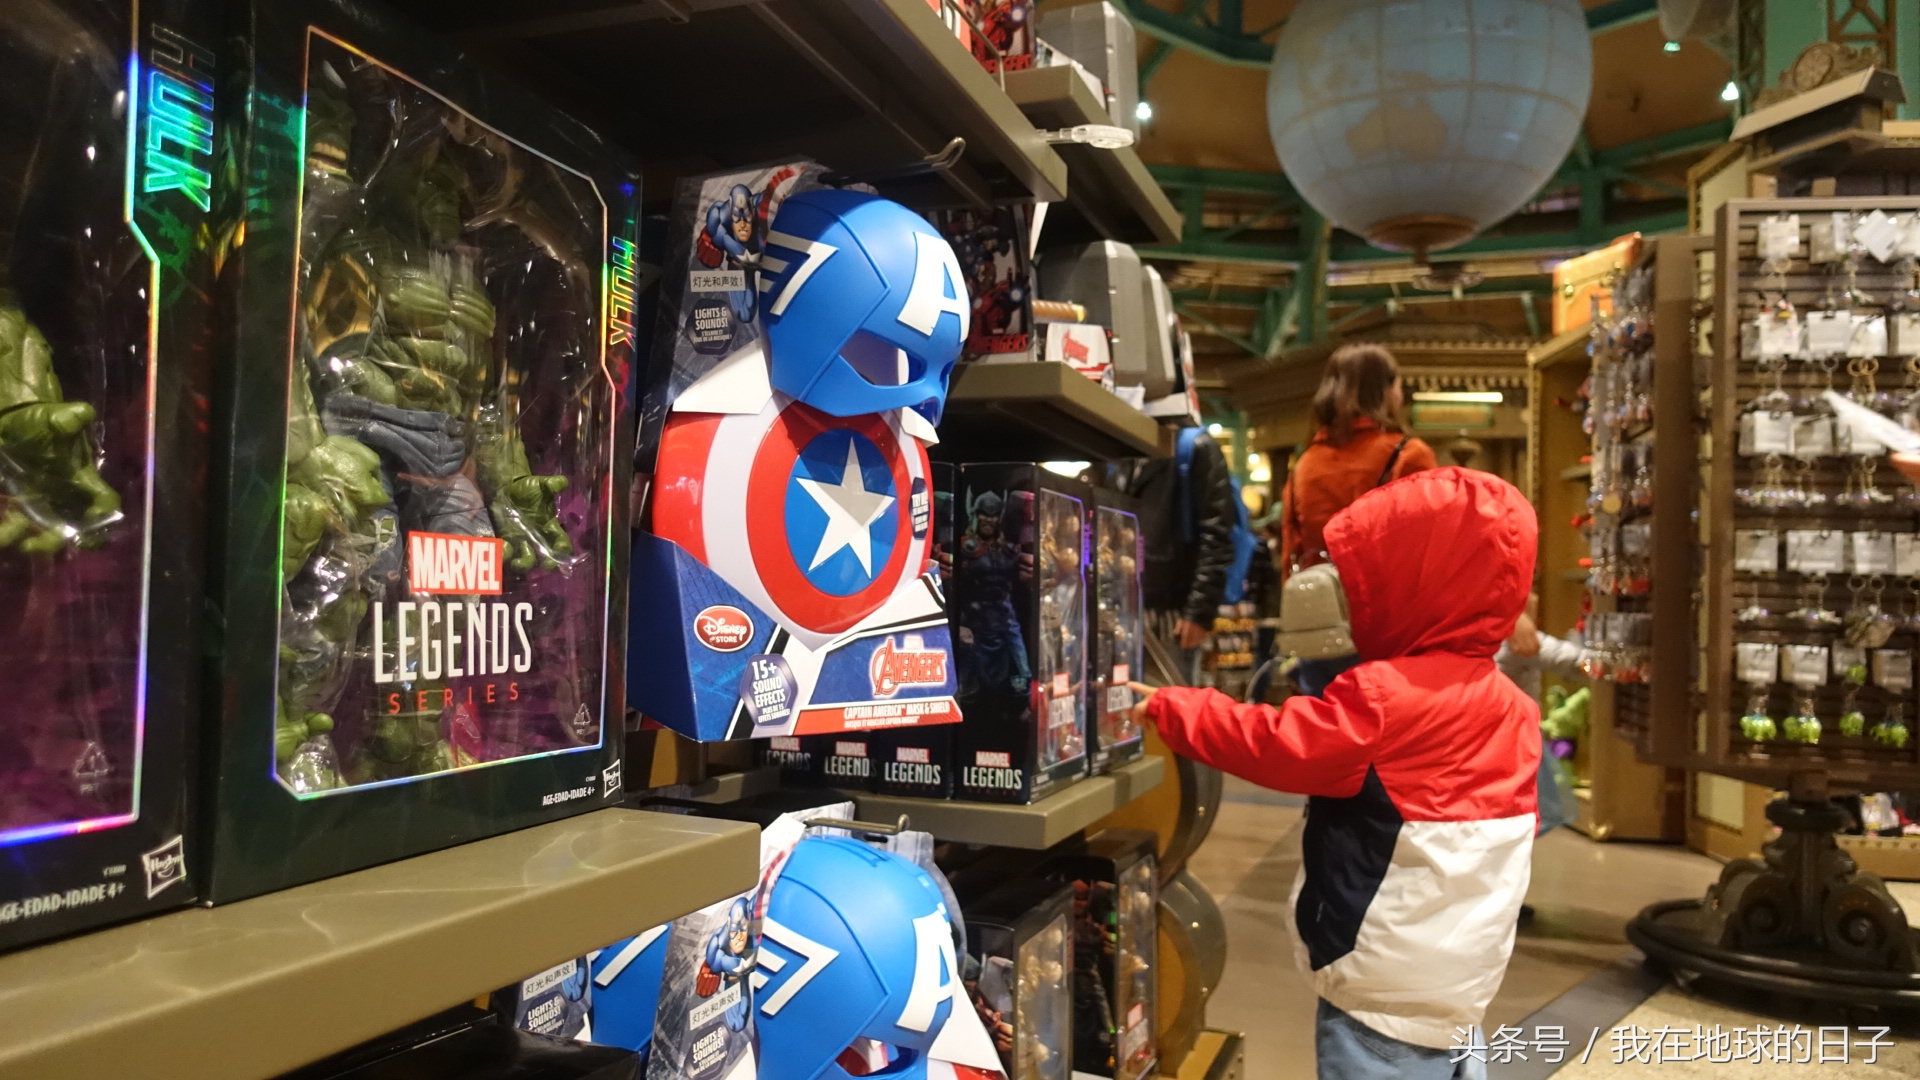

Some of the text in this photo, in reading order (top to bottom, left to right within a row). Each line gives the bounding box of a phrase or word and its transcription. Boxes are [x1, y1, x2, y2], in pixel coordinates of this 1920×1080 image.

[144, 22, 216, 213] HULK
[609, 235, 640, 353] HULK
[694, 306, 727, 320] LIGHTS &
[695, 317, 728, 331] SOUNDS!
[411, 535, 501, 591] MARVEL
[699, 615, 747, 641] Disney
[715, 635, 738, 643] STORE
[374, 601, 534, 684] LEGENDS
[752, 659, 778, 681] 15+
[871, 638, 946, 696] AVENGERS
[752, 676, 782, 695] SOUND
[388, 682, 519, 715] SERIES
[754, 688, 786, 708] EFFECTS
[844, 706, 873, 720] CAPTAIN
[905, 702, 924, 715] MASK
[929, 701, 950, 714] SHIELD
[835, 741, 867, 757] MARVEL
[896, 746, 930, 764] MARVEL
[975, 750, 1011, 769] MARVEL
[884, 761, 942, 786] LEGENDS
[963, 765, 1023, 791] LEGENDS
[107, 882, 126, 899] 4+
[528, 999, 553, 1021] LIGHTS
[528, 1006, 561, 1031] SOUNDS!
[692, 1030, 718, 1054] LIGHTS
[693, 1036, 725, 1064] SOUNDS!
